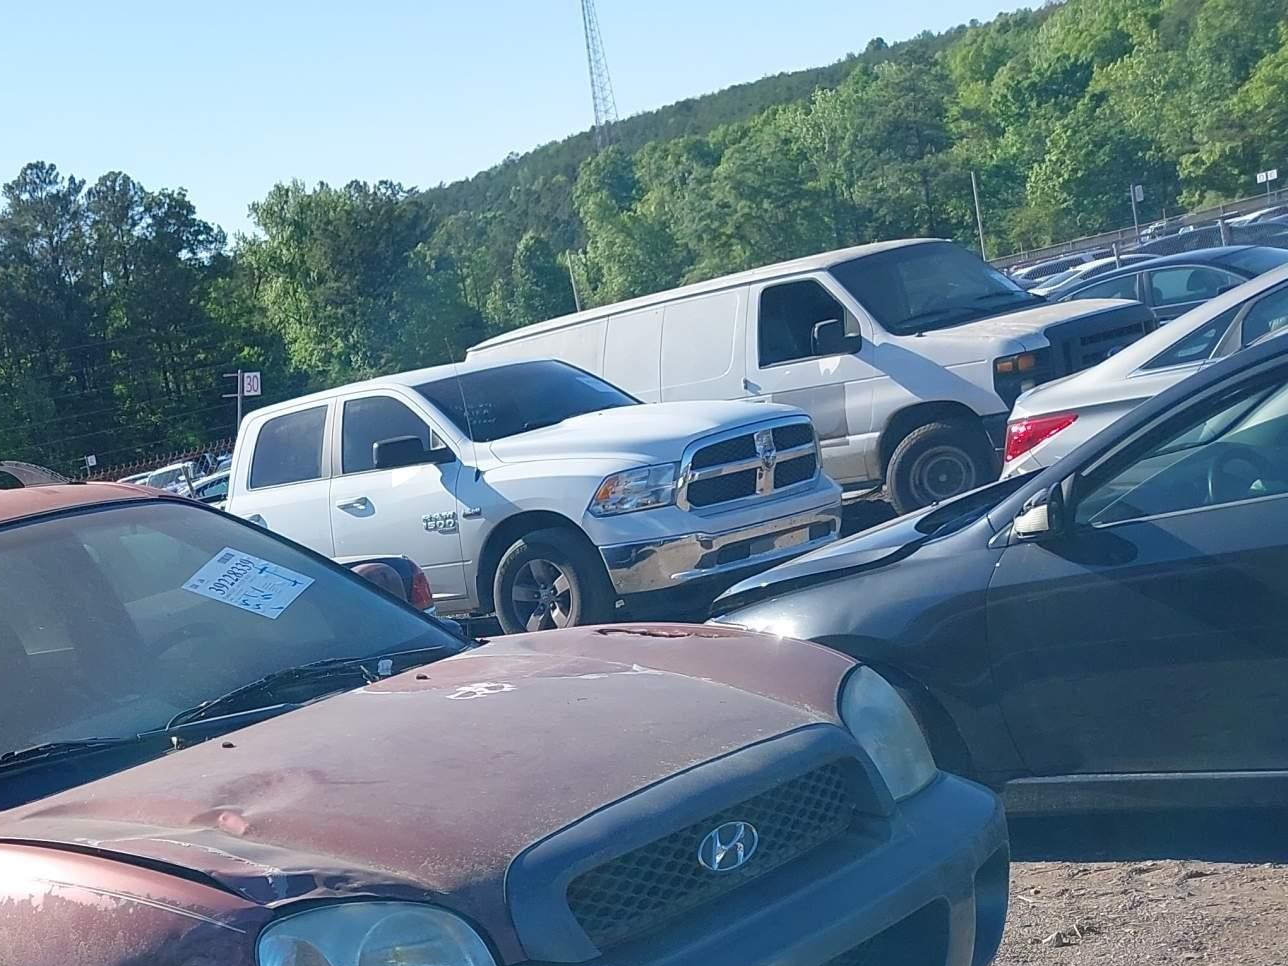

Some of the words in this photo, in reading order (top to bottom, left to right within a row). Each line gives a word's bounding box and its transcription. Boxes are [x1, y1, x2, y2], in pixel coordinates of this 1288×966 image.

[246, 375, 259, 392] 30
[423, 519, 455, 530] 1500
[208, 559, 255, 595] 39228339
